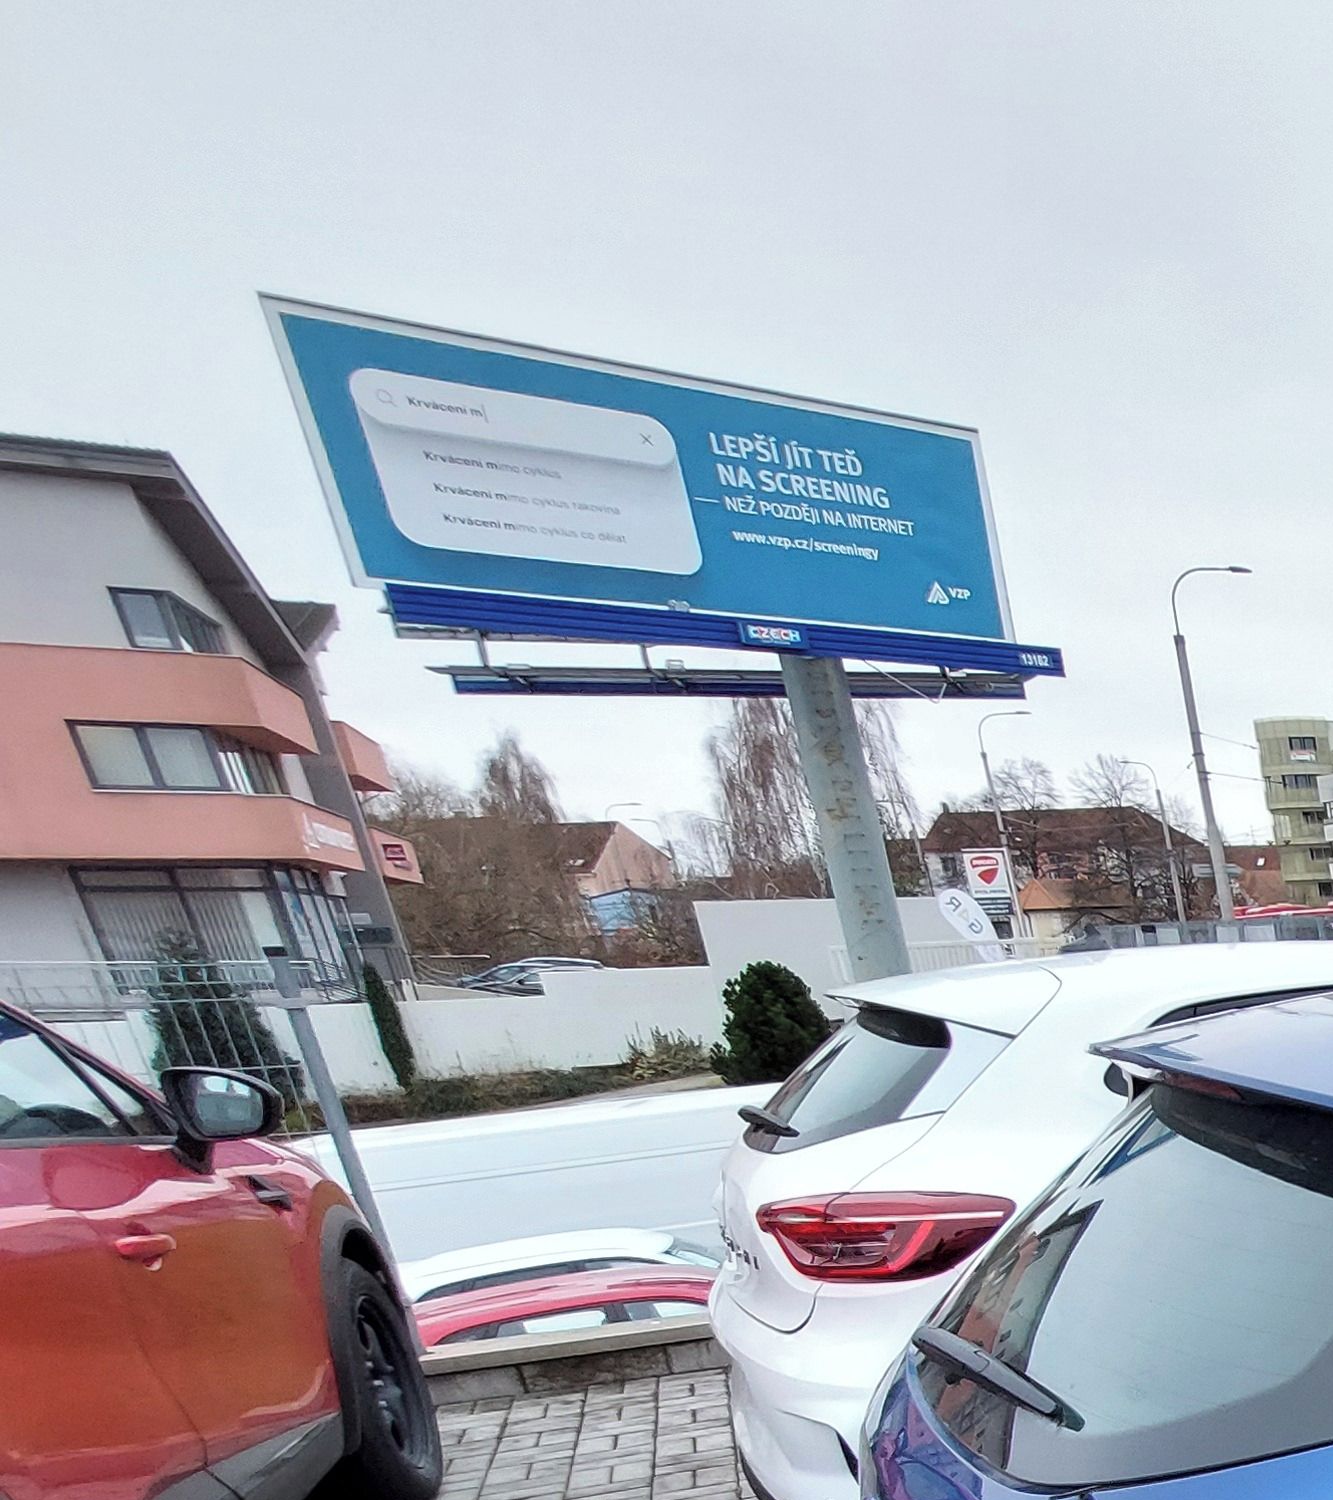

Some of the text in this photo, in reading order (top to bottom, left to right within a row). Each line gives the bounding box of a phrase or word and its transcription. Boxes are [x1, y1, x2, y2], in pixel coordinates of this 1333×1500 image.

[709, 432, 863, 477] LEPŠÍ JÍT TEĎ
[716, 463, 891, 509] NA SCREENING
[725, 495, 914, 536] NEŽ POZDĚJI NA INTERNET
[731, 530, 879, 561] www.vzp.cz/screeningy
[950, 587, 971, 600] VZP
[747, 624, 801, 642] CZECH
